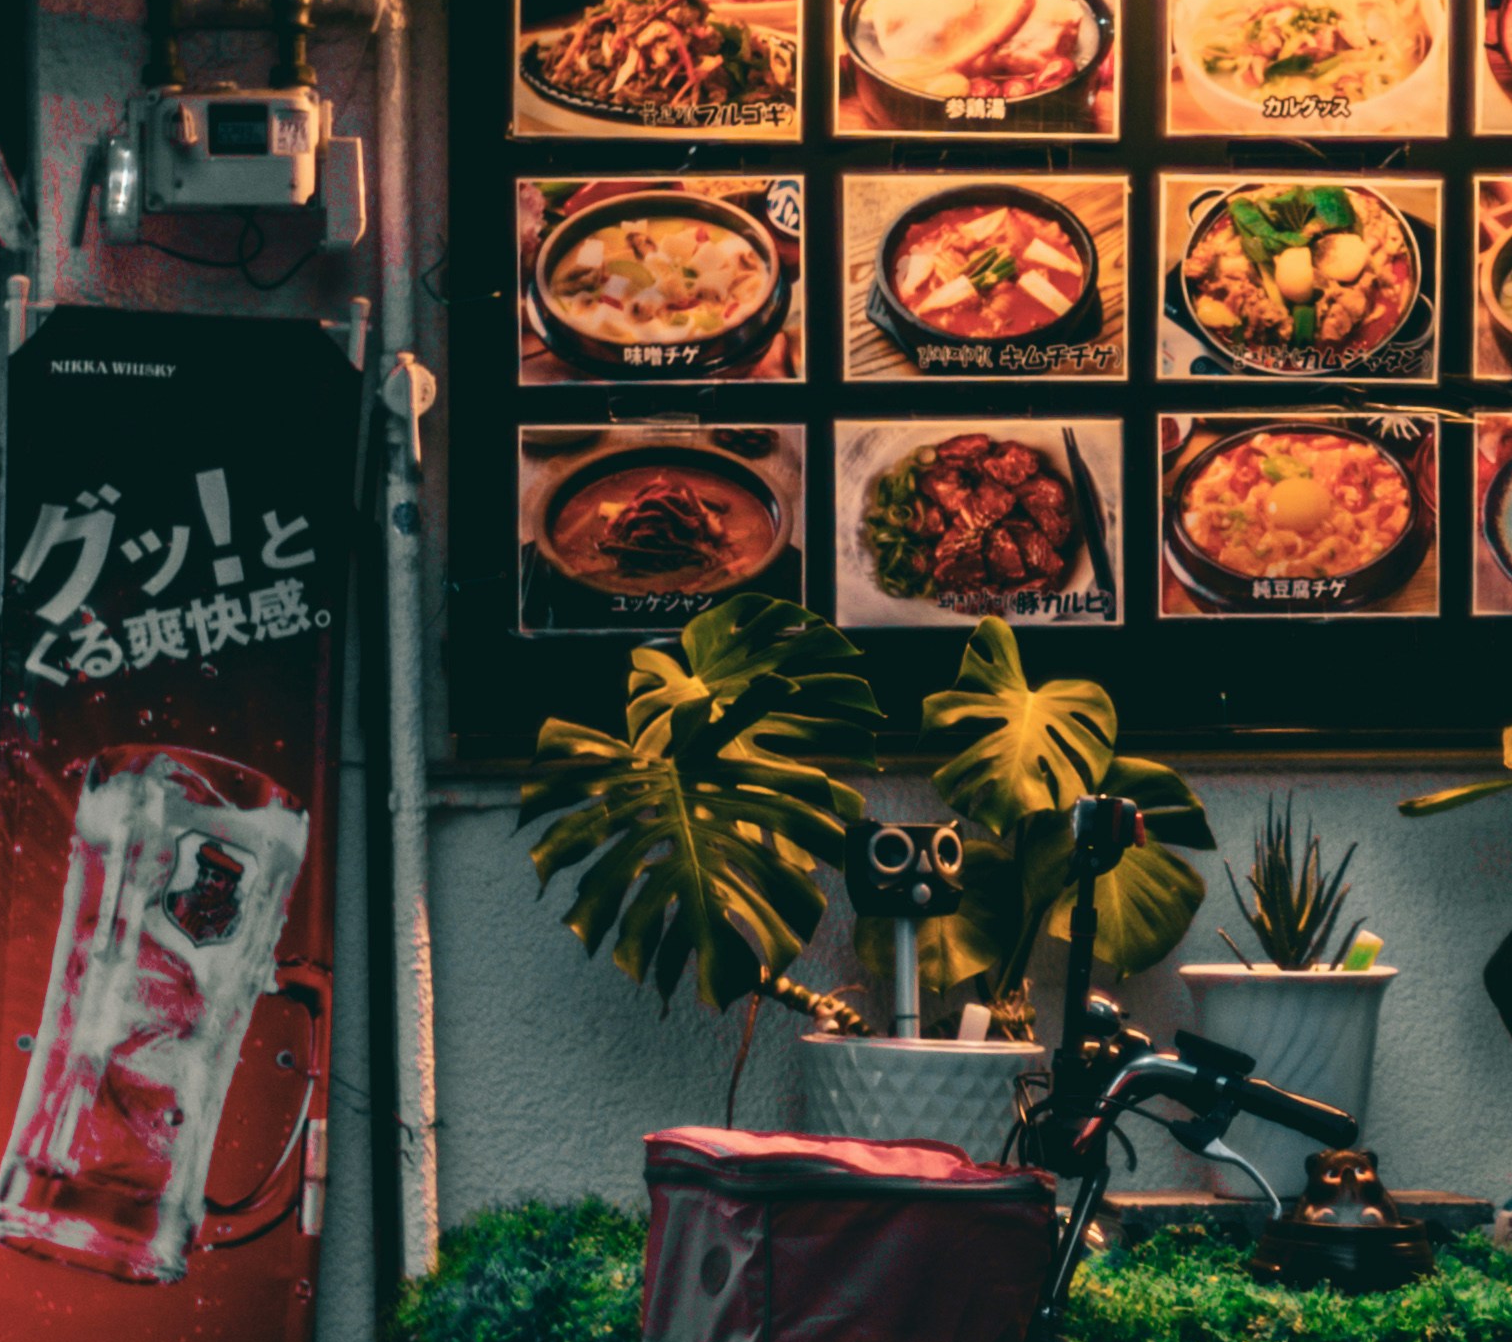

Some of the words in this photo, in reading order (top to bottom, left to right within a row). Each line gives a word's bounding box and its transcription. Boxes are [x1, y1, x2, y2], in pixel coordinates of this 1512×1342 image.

[50, 359, 109, 376] NIKKA
[112, 360, 176, 378] WHISKY
[610, 593, 714, 613] ユッケジャン
[25, 578, 332, 687] くる爽快感。
